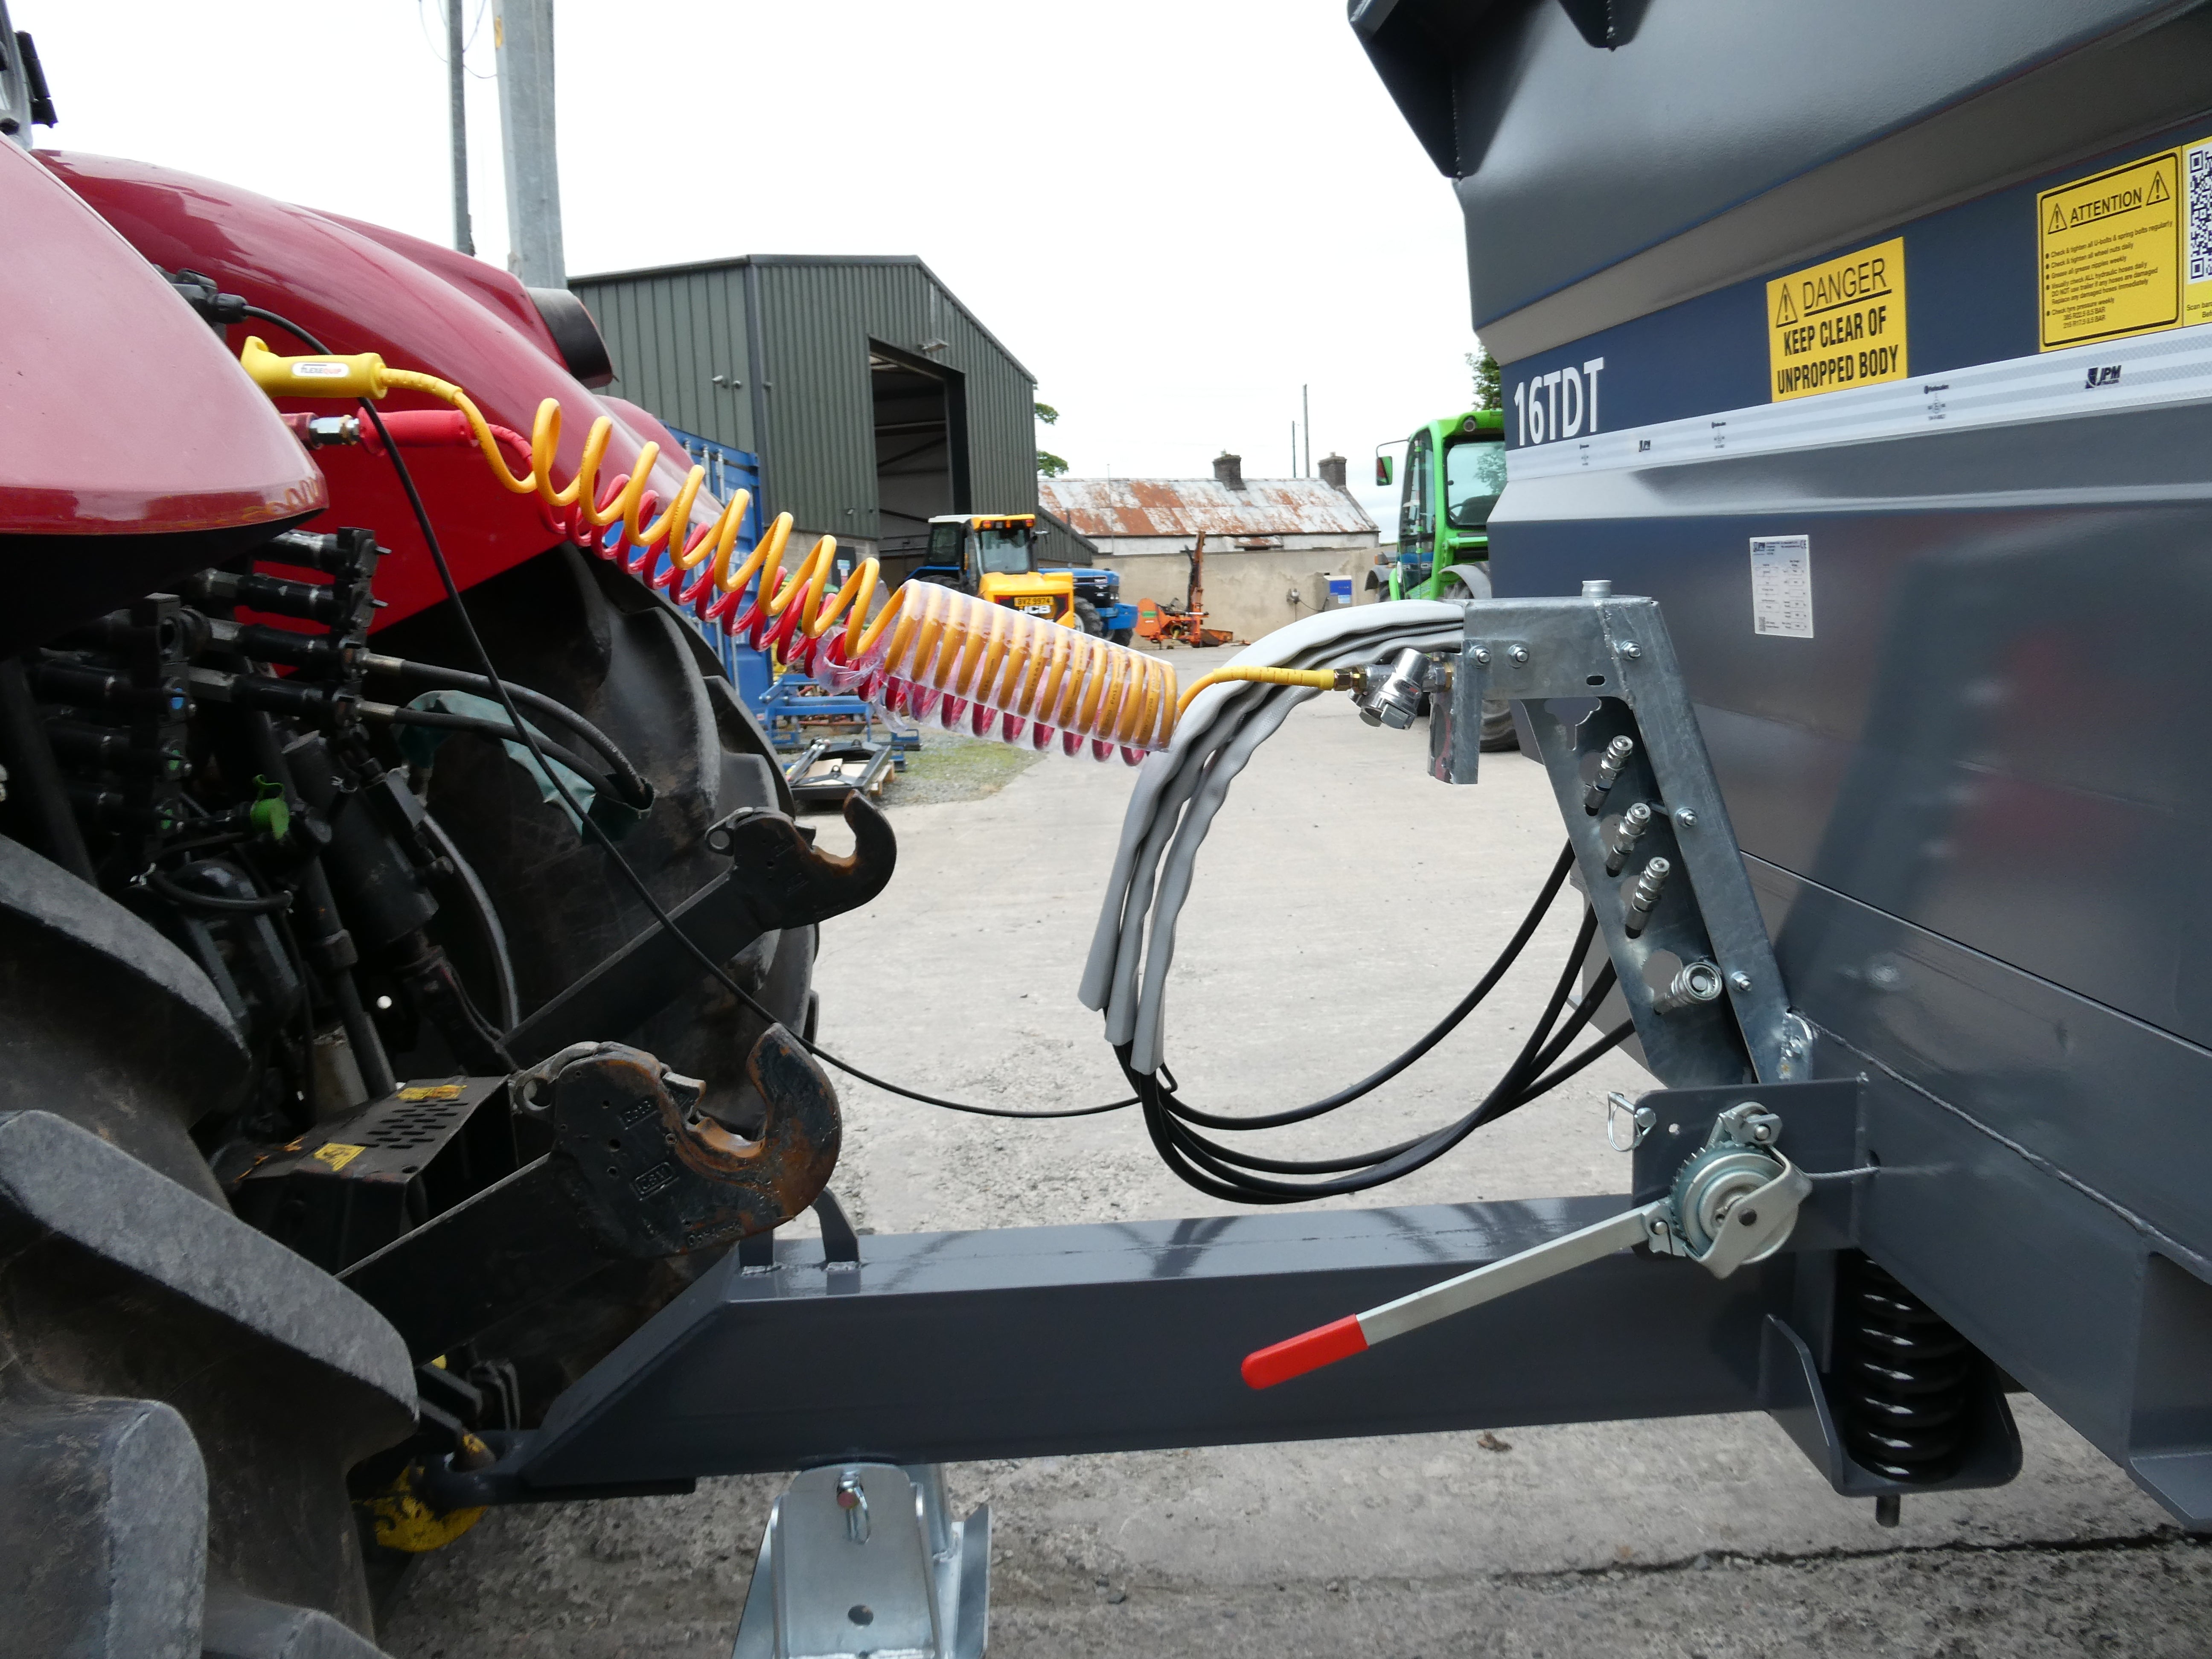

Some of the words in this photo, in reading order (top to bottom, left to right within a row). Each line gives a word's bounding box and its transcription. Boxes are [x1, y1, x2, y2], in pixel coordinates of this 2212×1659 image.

[2070, 187, 2142, 224] ATTENTION
[1802, 258, 1887, 310] DANGER
[1784, 325, 1815, 356] KEEP
[1820, 312, 1863, 348] CLEAR
[1868, 305, 1886, 336] OF
[1777, 354, 1854, 394] UNPROPPED
[1860, 344, 1898, 378] BODY
[1514, 357, 1604, 446] 16TDT
[1019, 605, 1051, 614] JCB
